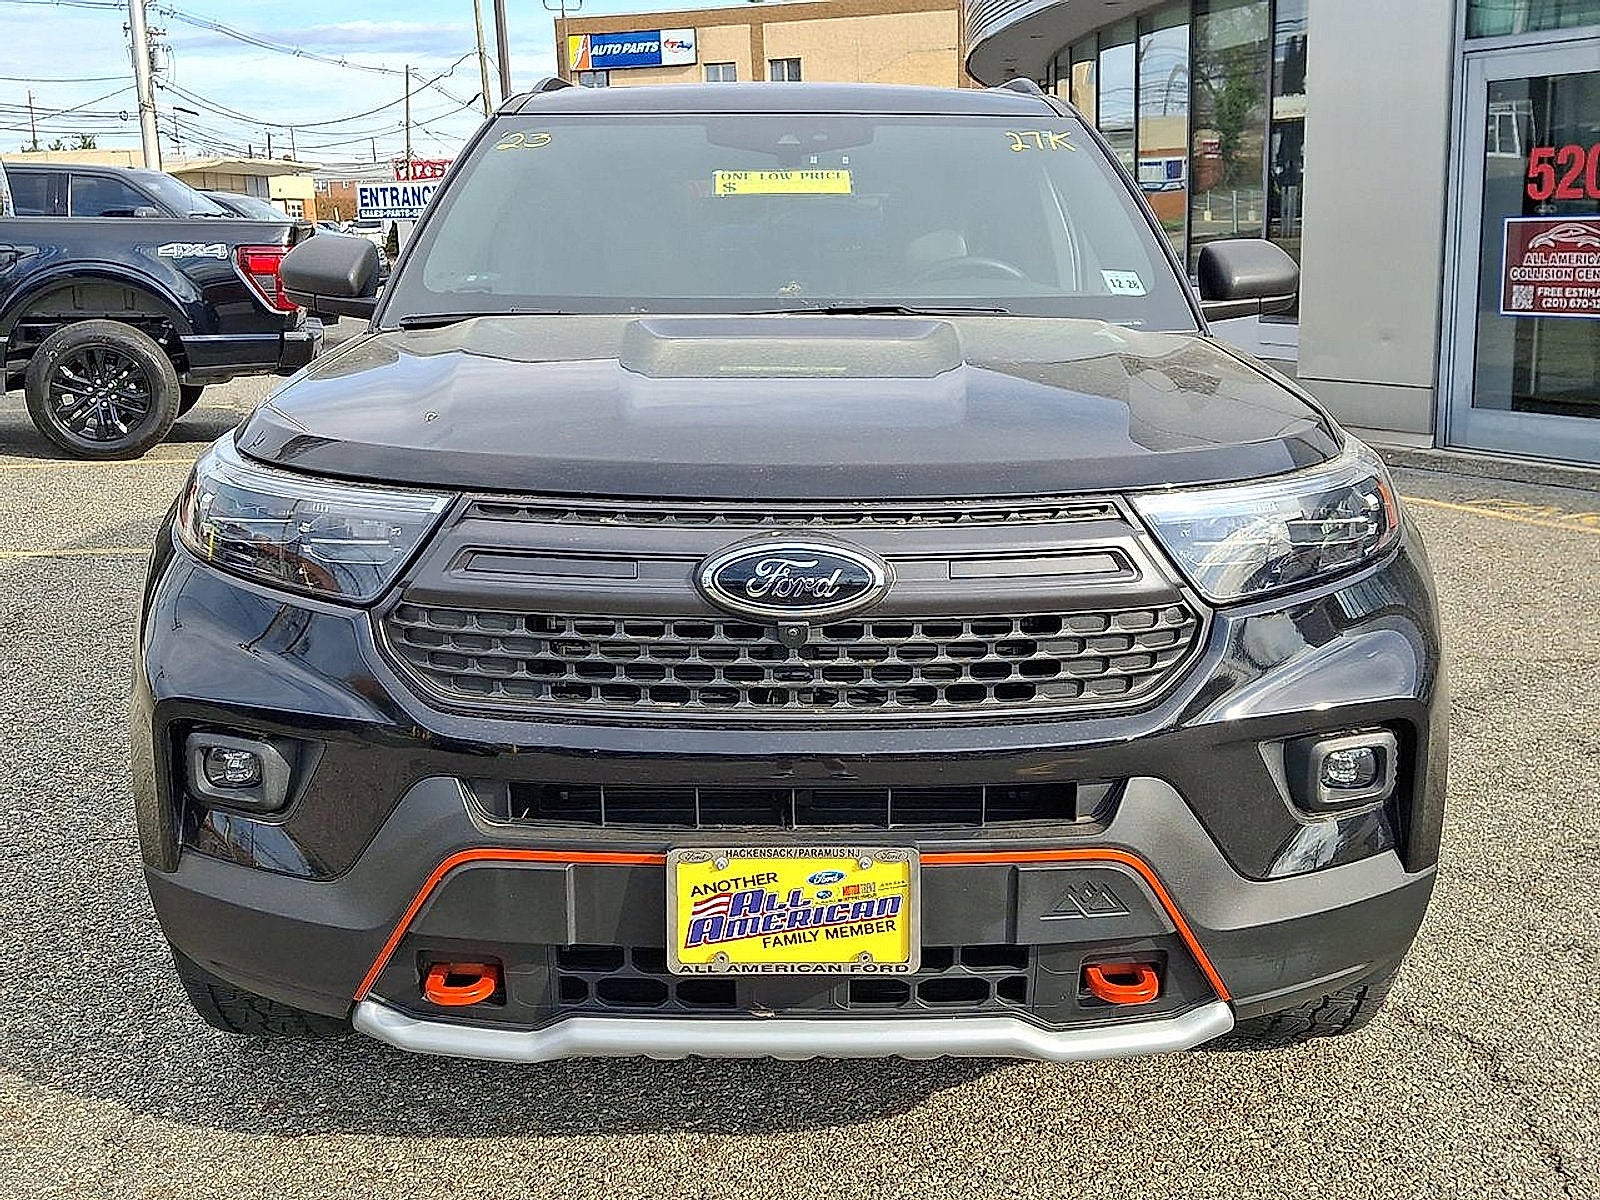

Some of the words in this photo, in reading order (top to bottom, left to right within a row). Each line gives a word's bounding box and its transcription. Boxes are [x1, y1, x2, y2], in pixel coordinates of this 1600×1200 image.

[592, 42, 623, 56] AUTO
[622, 41, 659, 54] PARTS
[1005, 131, 1076, 152] 27K
[721, 172, 751, 180] ONE
[760, 172, 793, 180] LOW
[800, 172, 842, 180] PRICE
[722, 182, 736, 193] $
[360, 185, 439, 208] ENTRANC
[1523, 252, 1549, 267] ALL
[1510, 266, 1574, 282] COLLISION
[1537, 286, 1564, 298] FREE
[1541, 297, 1568, 310] (201)
[745, 558, 843, 599] Ford
[725, 848, 845, 859] HACKENSACK/PARAMUS
[847, 848, 860, 858] NJ
[691, 872, 779, 898] ANOTHER
[728, 888, 812, 918] ALL
[686, 895, 902, 945] AMERICAN
[763, 929, 820, 949] FAMILY
[825, 919, 897, 940] MEMBER
[680, 965, 718, 974] ALL
[726, 964, 841, 974] AMERICAN
[850, 964, 909, 973] FORD
